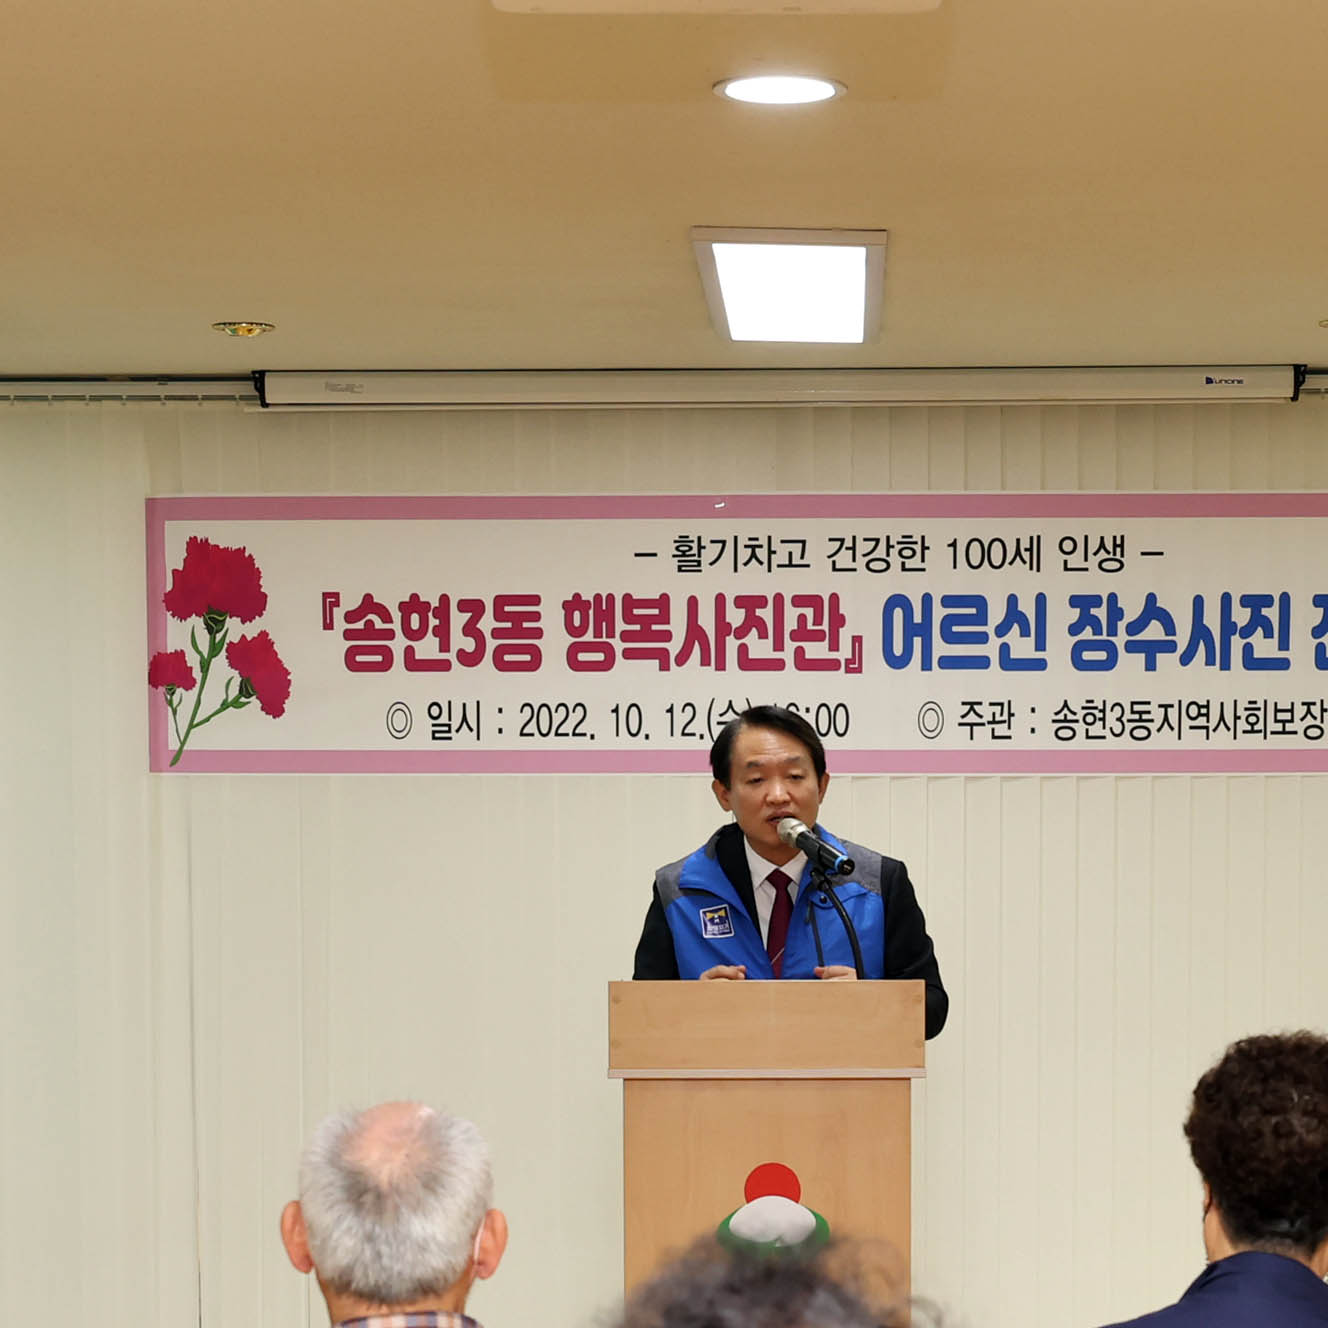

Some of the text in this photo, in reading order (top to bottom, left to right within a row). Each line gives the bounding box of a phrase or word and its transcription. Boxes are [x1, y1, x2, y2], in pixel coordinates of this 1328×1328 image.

[671, 534, 811, 574] 활기차고
[826, 534, 931, 574] 건강한
[946, 533, 1042, 573] 100세
[1057, 533, 1126, 574] 인생
[321, 591, 544, 673] 『송현3동
[561, 592, 863, 674] 행복사진관』
[882, 591, 1048, 672] 어르신
[1067, 591, 1291, 672] 장수사진
[426, 699, 481, 742] 일시
[518, 701, 596, 741] 2022.
[610, 702, 650, 741] 10.
[665, 697, 753, 743] 12.(수
[957, 699, 1016, 741] 주관
